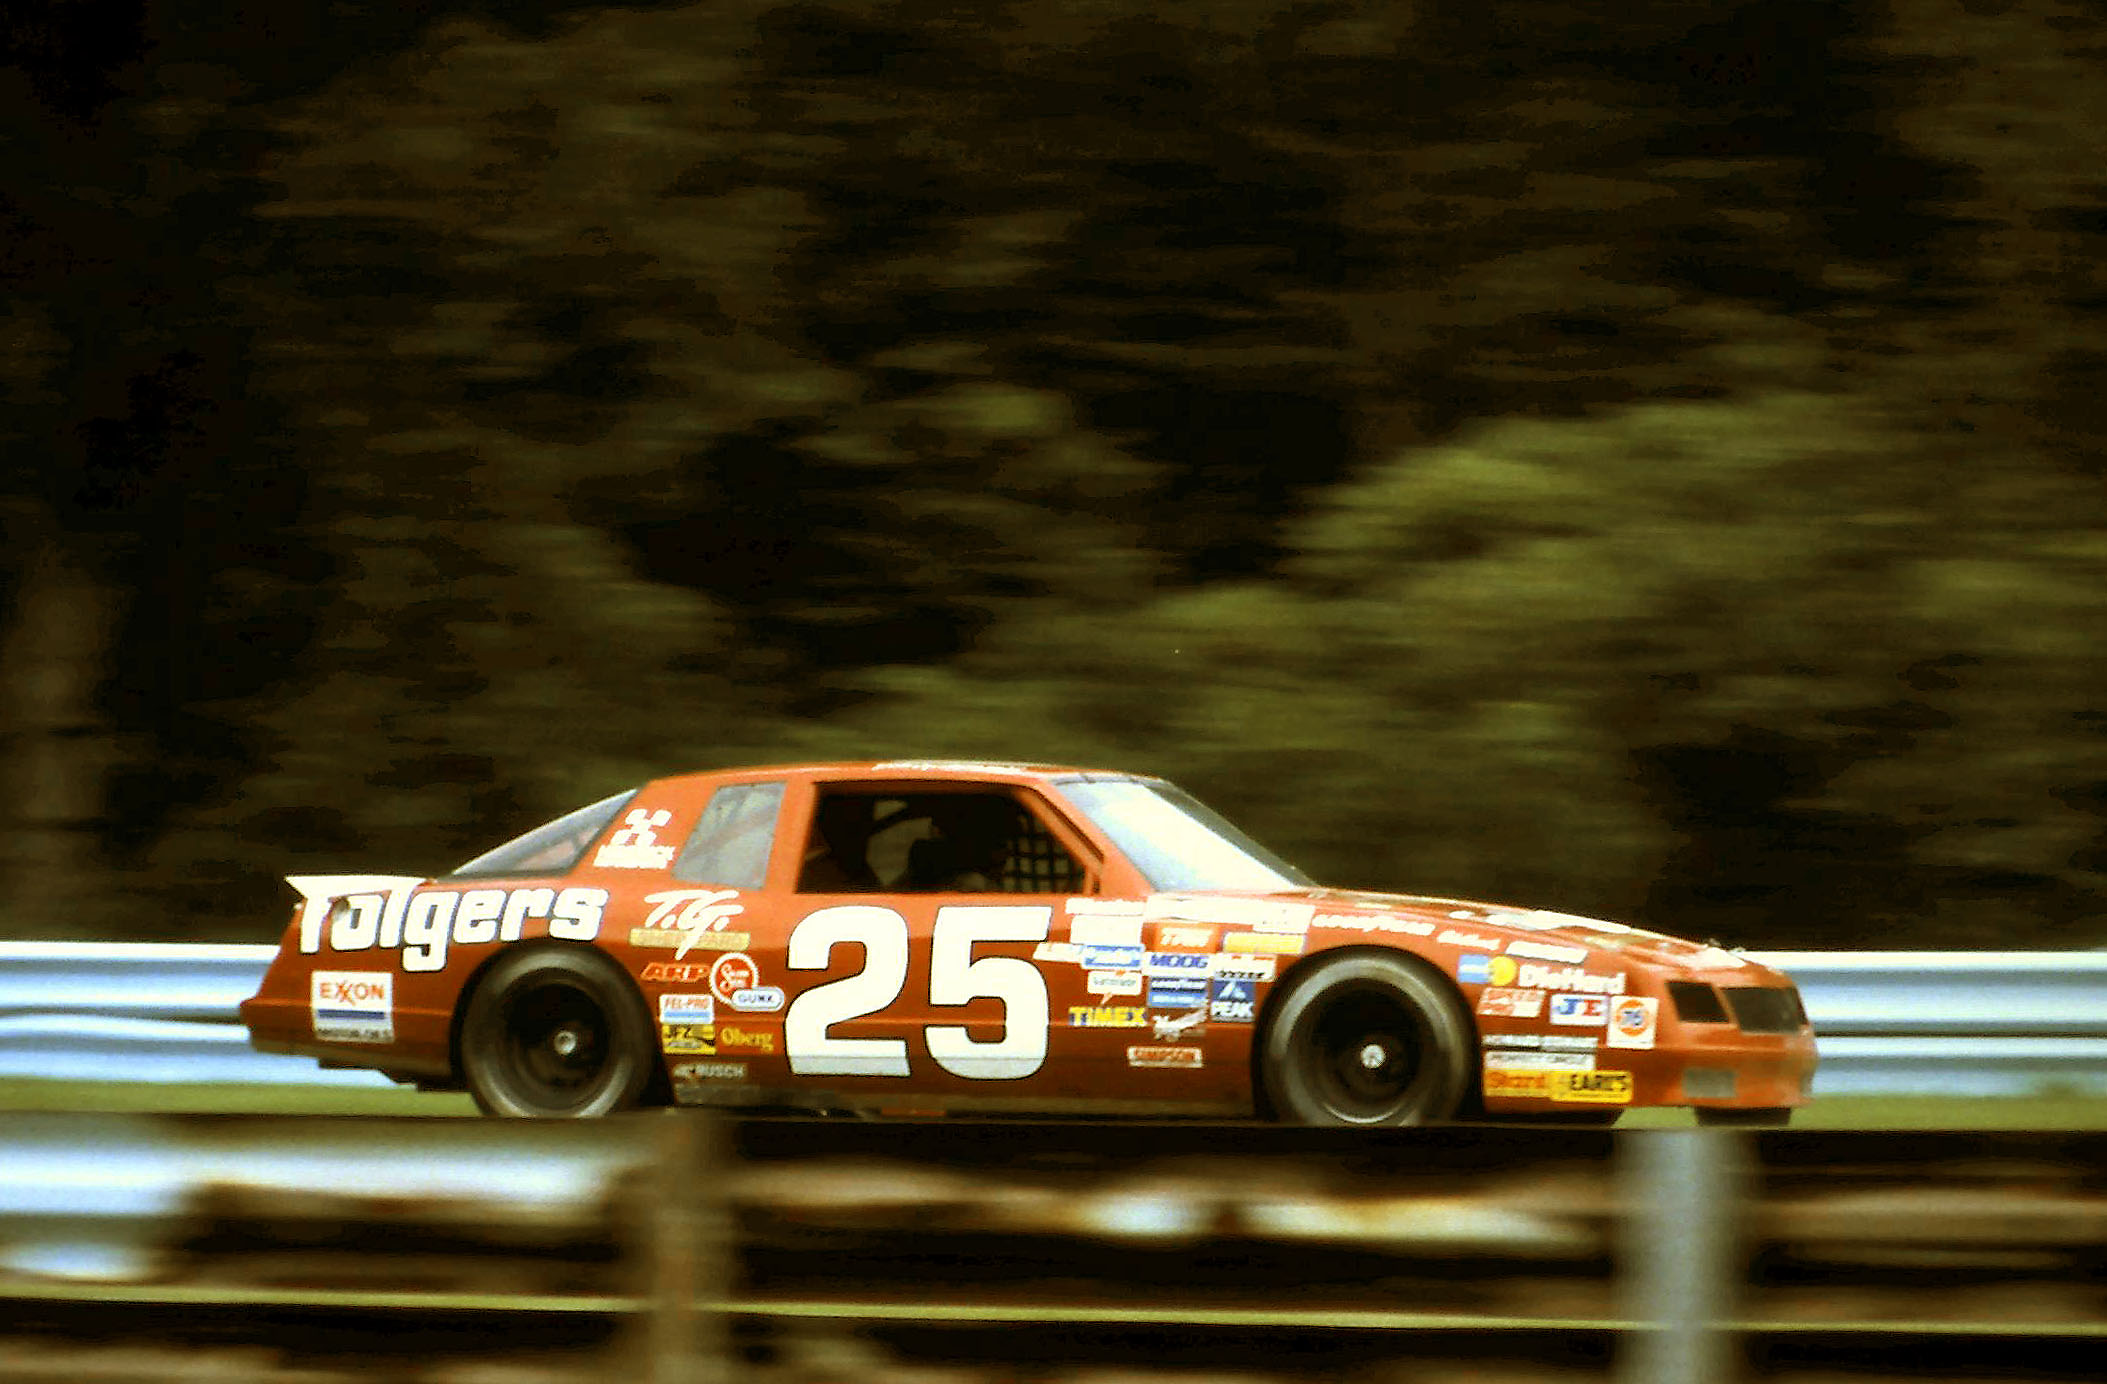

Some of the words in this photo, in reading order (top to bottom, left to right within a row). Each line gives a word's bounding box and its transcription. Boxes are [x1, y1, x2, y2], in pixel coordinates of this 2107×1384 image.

[285, 875, 609, 973] Folgers
[1150, 952, 1208, 969] MOOG
[1518, 963, 1626, 994] DieHard
[319, 979, 385, 1006] EXXON
[784, 904, 1053, 1081] 25
[1068, 1007, 1148, 1028] TIMEX
[1211, 1001, 1254, 1018] PEAK
[721, 1027, 774, 1054] Oberg
